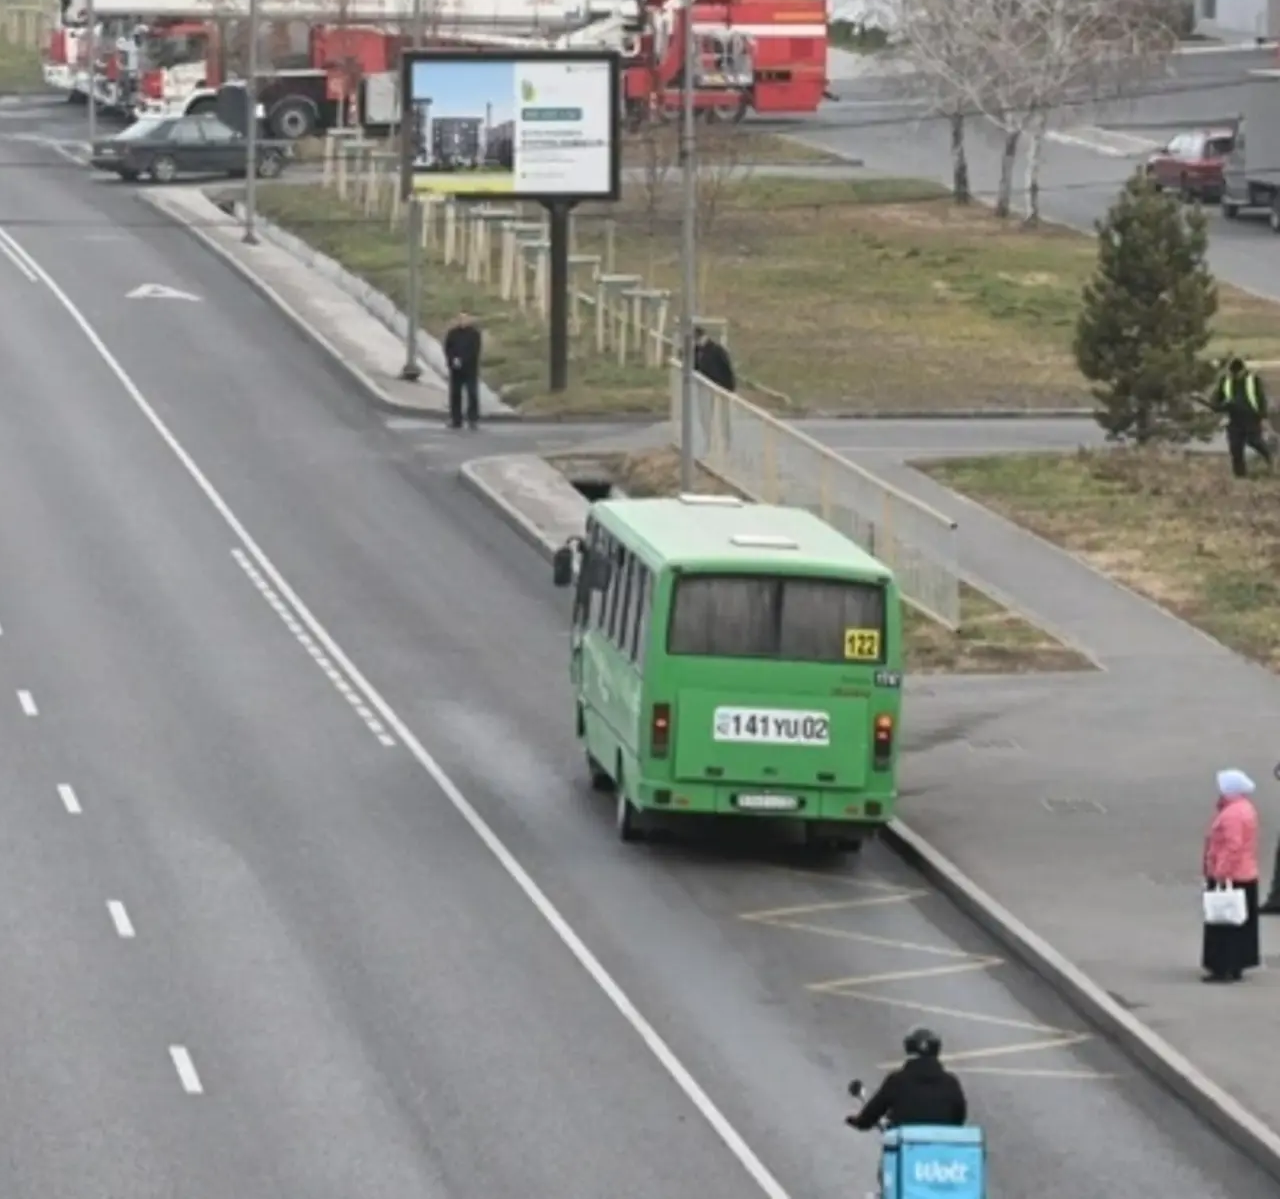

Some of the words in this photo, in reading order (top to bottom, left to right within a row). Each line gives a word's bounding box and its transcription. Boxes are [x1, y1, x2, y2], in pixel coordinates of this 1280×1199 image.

[847, 634, 876, 656] 122
[732, 713, 770, 737] 141
[802, 715, 829, 739] 02
